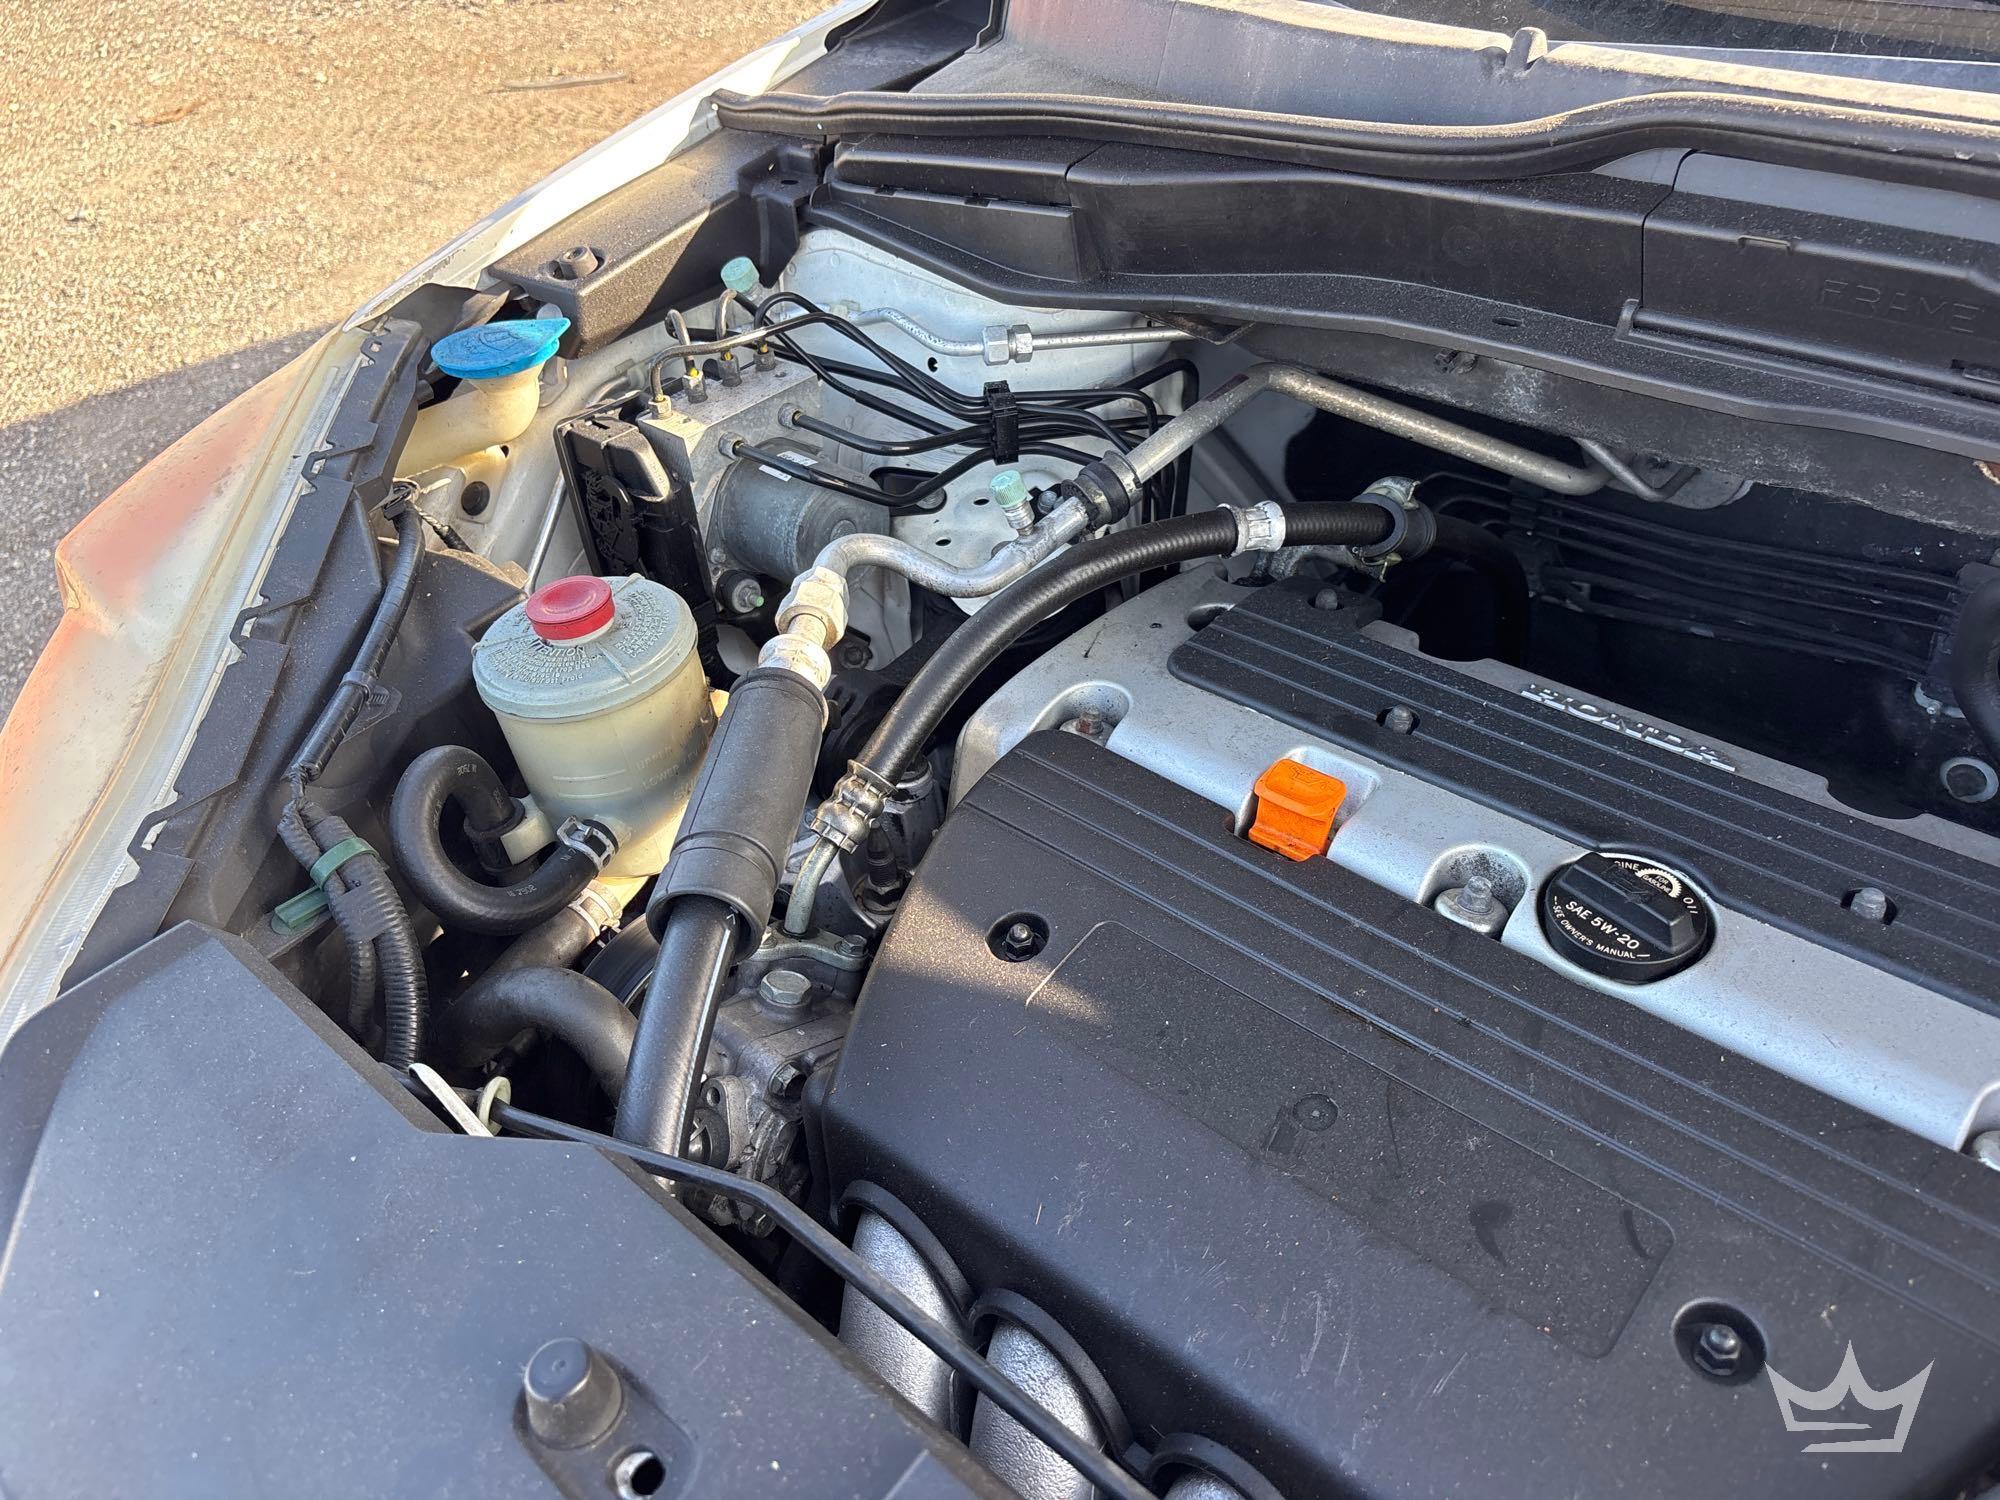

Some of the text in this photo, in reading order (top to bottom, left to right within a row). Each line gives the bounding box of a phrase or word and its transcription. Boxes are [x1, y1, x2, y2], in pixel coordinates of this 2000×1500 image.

[1552, 905, 1637, 959] SEE OWNER'S MANUAL
[1565, 901, 1640, 950] SAE 5W-20
